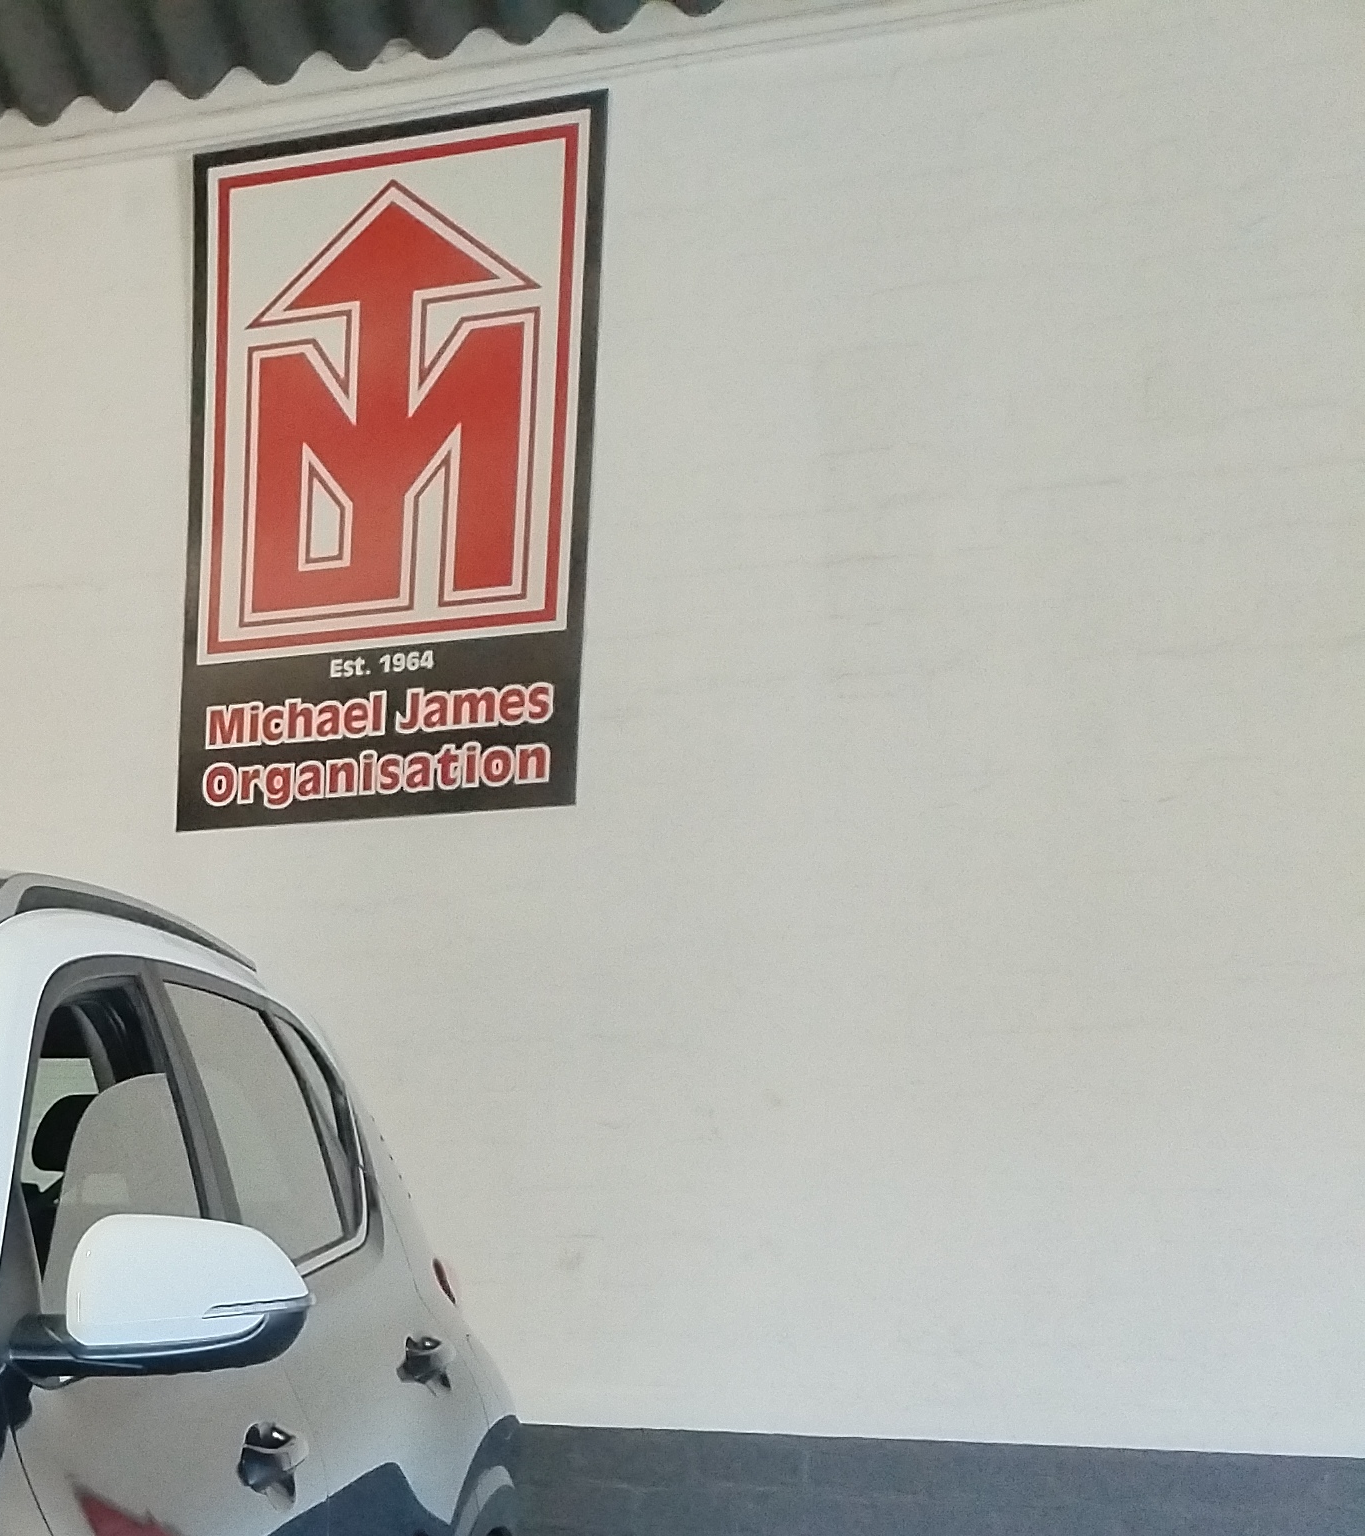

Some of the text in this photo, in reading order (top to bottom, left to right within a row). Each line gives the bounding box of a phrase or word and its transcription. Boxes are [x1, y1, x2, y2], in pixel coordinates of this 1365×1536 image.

[330, 650, 435, 678] Est. 1964
[205, 682, 554, 750] Michael James
[203, 741, 551, 809] Organisation
